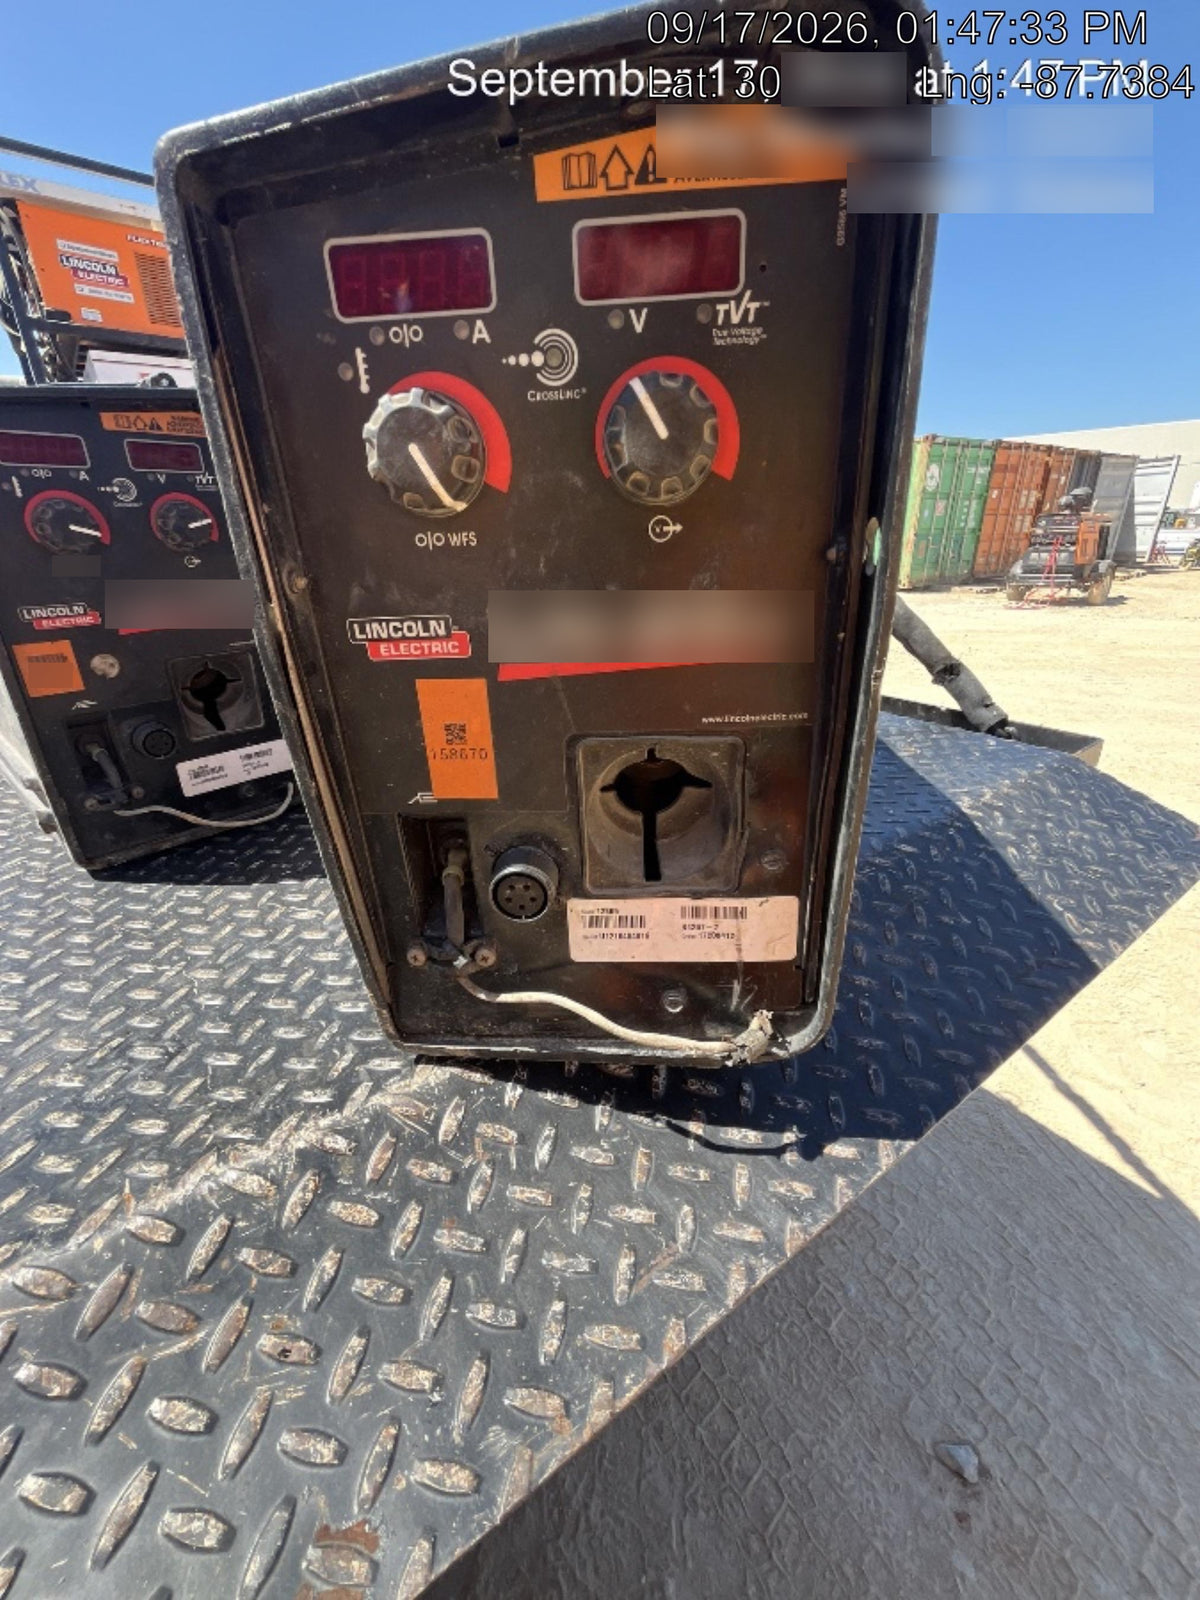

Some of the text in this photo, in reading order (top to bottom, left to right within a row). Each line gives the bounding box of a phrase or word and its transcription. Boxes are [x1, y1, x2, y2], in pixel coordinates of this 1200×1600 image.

[61, 254, 117, 276] LINCOLN
[628, 307, 648, 334] V
[472, 319, 492, 344] A
[80, 470, 90, 481] A
[157, 473, 166, 484] V
[447, 531, 478, 547] WFS
[23, 605, 85, 620] LINCOLN
[353, 619, 447, 640] LINCOLN
[379, 641, 460, 656] ELECTRIC
